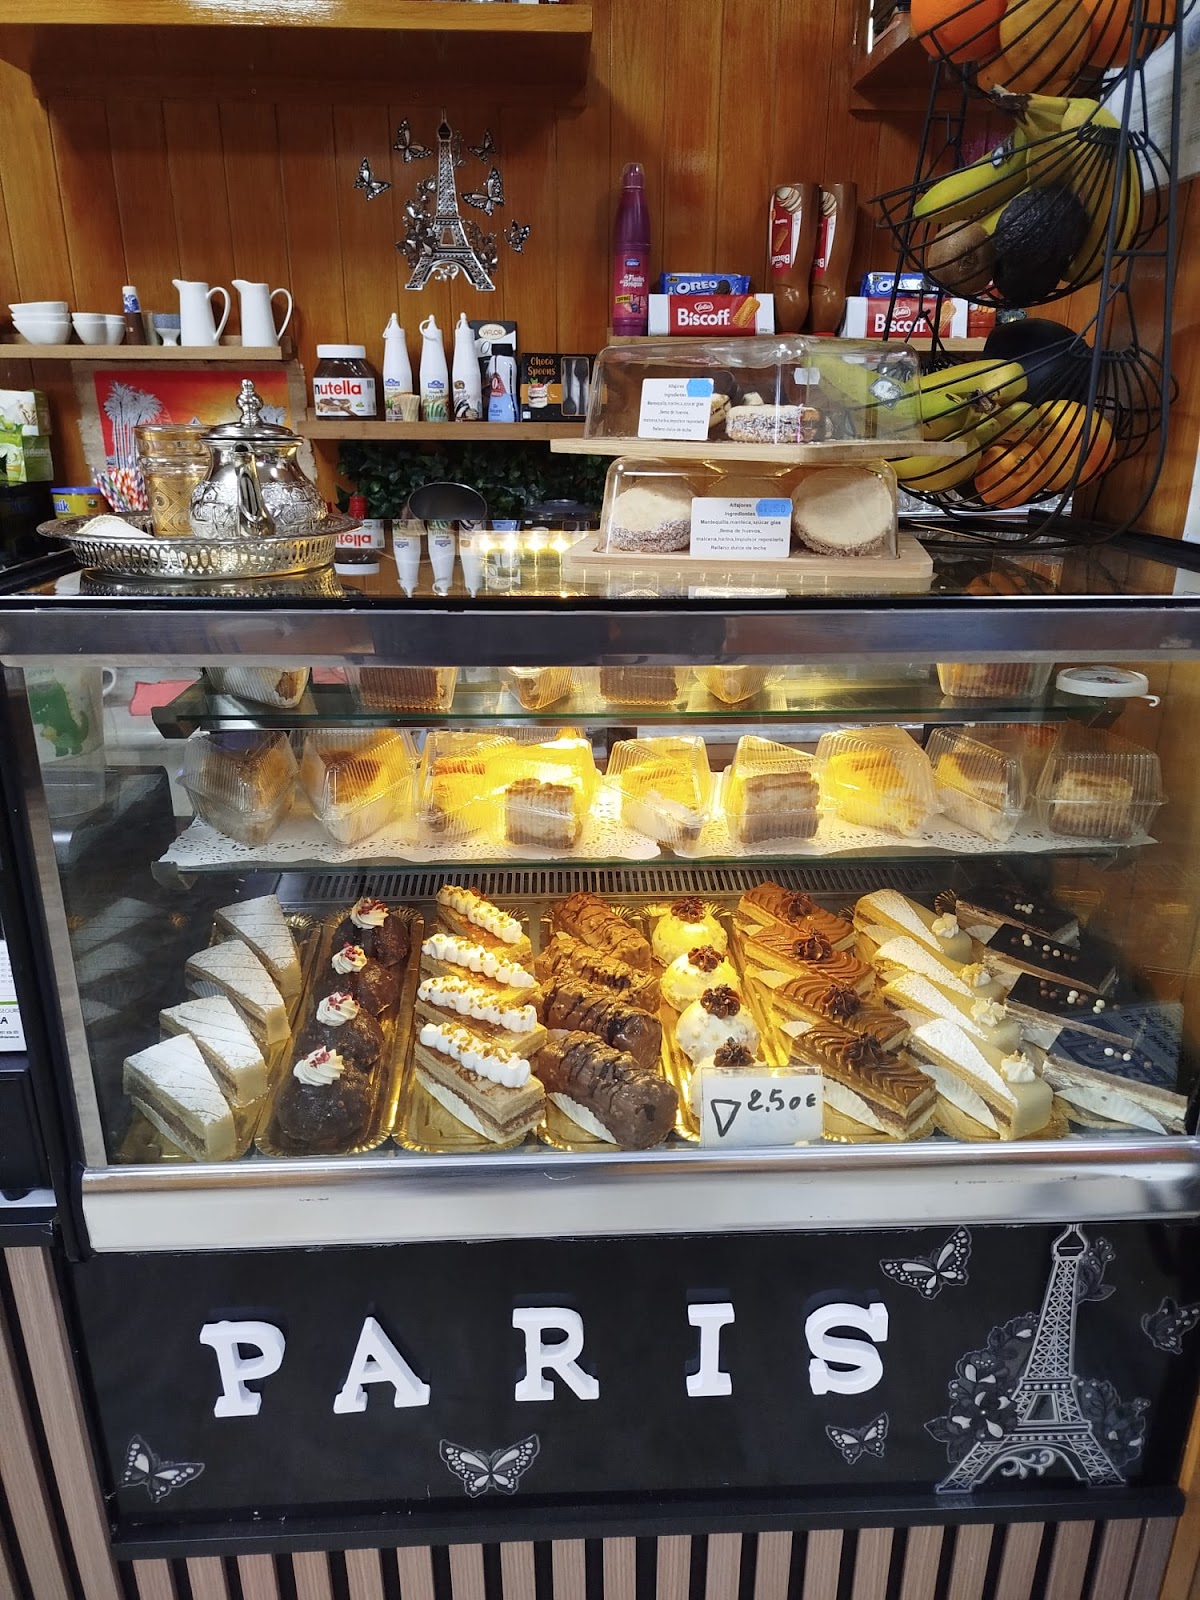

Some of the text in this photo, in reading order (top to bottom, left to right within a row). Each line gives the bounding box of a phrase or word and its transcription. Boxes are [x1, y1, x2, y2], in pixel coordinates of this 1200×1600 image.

[676, 280, 718, 294] OREO
[677, 308, 730, 326] Biscoff
[874, 313, 926, 333] Bscoff
[530, 357, 554, 366] Choco
[527, 366, 556, 377] Spoons
[314, 380, 362, 395] nutella
